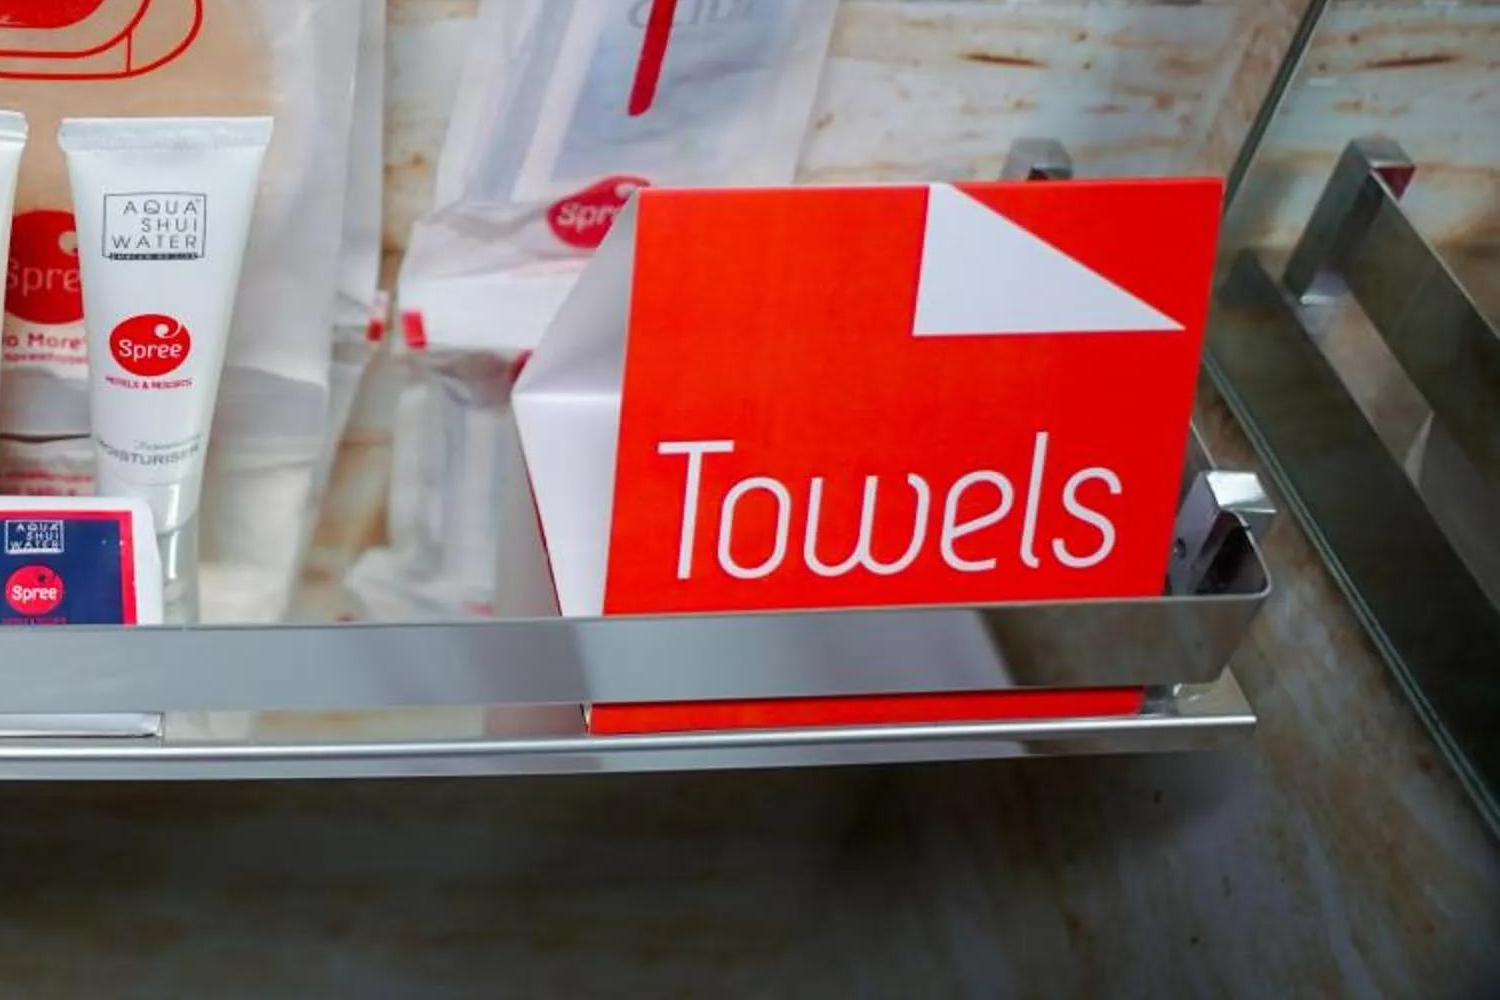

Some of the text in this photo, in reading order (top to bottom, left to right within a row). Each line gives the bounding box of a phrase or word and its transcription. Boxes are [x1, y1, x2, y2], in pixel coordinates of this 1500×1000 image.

[123, 199, 197, 215] AQUA
[141, 217, 197, 233] SHUI
[557, 202, 614, 233] Spr
[111, 234, 197, 249] WATER
[7, 257, 80, 297] Spre
[118, 339, 182, 363] Spree
[657, 431, 1122, 580] Towels
[16, 523, 59, 532] AQUA
[10, 540, 59, 549] WATER
[26, 532, 59, 541] SHUI
[12, 584, 57, 604] Spree
